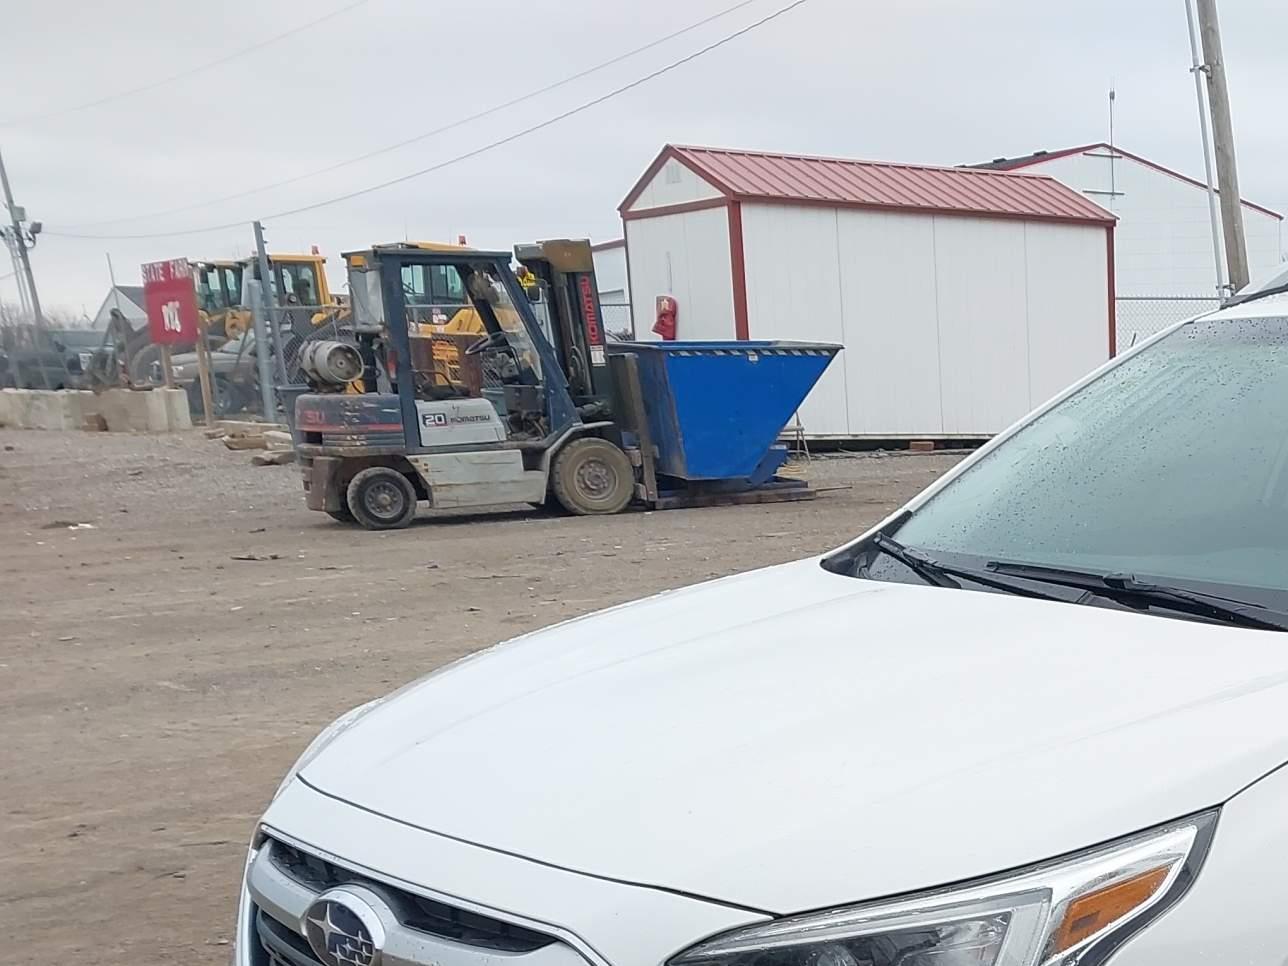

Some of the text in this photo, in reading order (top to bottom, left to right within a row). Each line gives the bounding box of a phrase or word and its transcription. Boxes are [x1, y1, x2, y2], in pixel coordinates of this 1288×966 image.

[141, 262, 166, 284] STATE
[579, 273, 599, 346] KOMATSU
[423, 414, 491, 426] 20 KOMATSU
